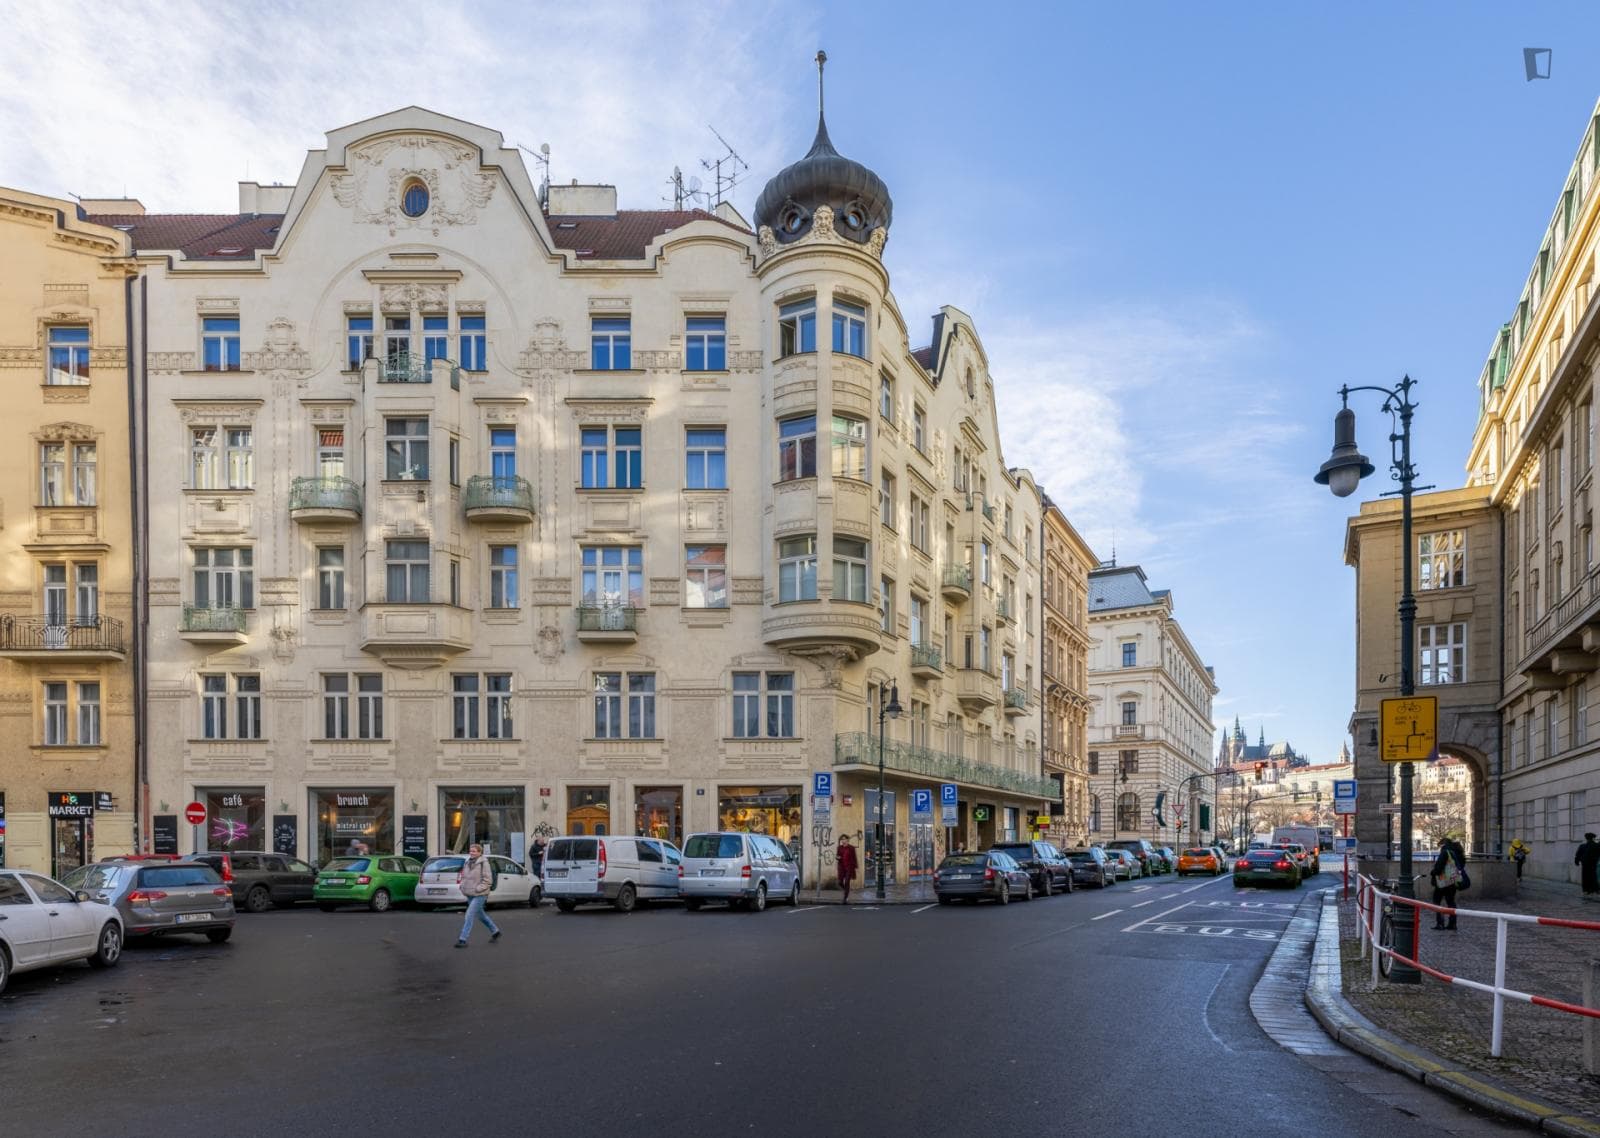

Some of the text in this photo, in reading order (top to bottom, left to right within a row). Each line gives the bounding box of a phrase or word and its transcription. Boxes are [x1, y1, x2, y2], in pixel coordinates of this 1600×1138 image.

[817, 775, 828, 789] P
[917, 792, 928, 806] P
[944, 786, 954, 799] P
[223, 793, 242, 806] café
[337, 793, 369, 806] brunch
[49, 806, 92, 815] MARKET
[1153, 925, 1277, 939] BUS
